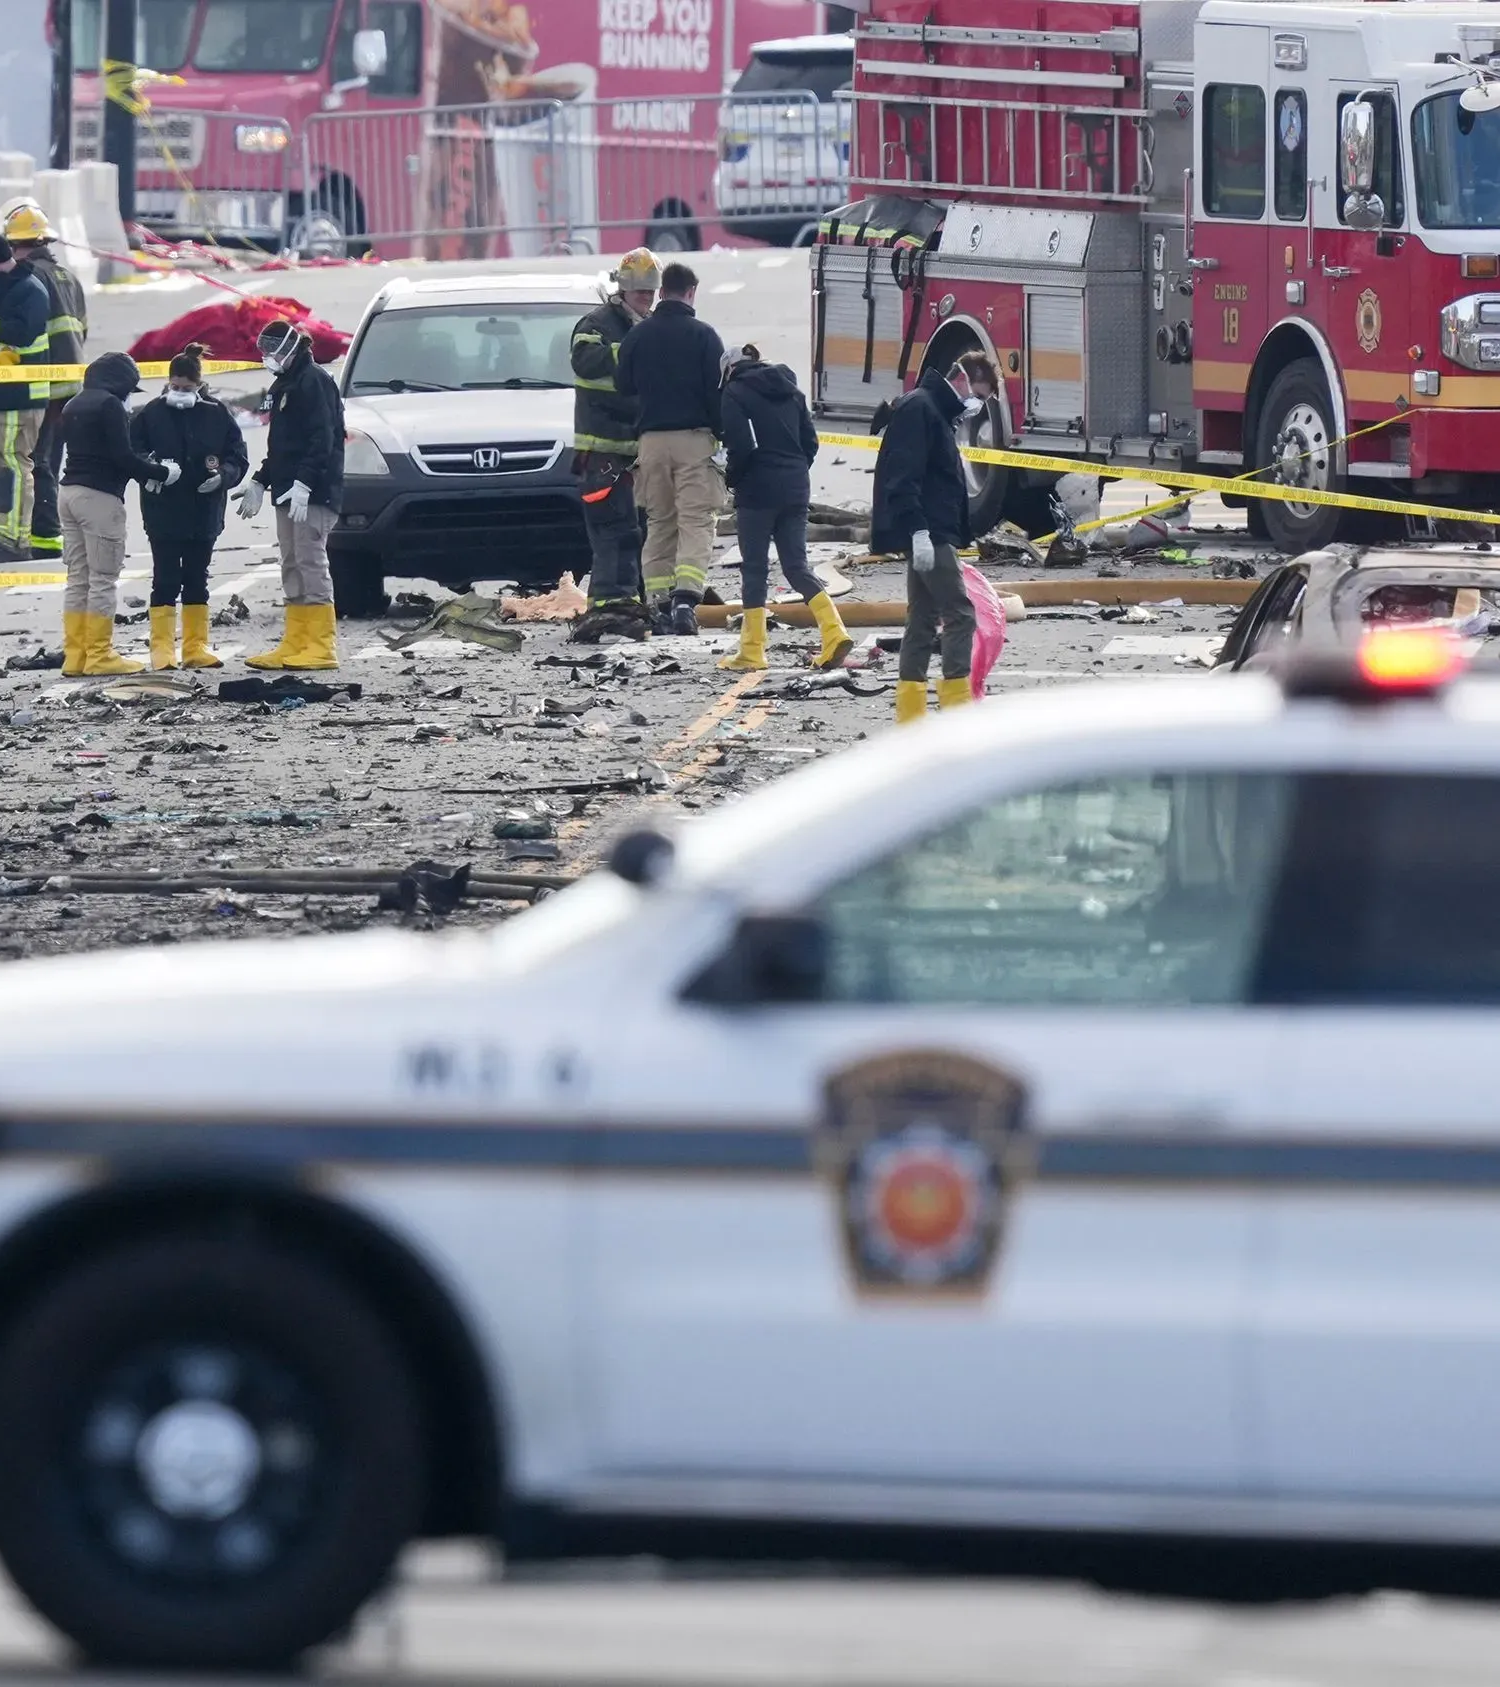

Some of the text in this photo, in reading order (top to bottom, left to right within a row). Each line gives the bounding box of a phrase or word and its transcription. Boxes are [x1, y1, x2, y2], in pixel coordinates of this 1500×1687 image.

[599, 0, 712, 33] KEEP YOU
[599, 33, 710, 72] RUNNING
[1214, 284, 1247, 301] ENGINE
[1223, 307, 1239, 344] 18
